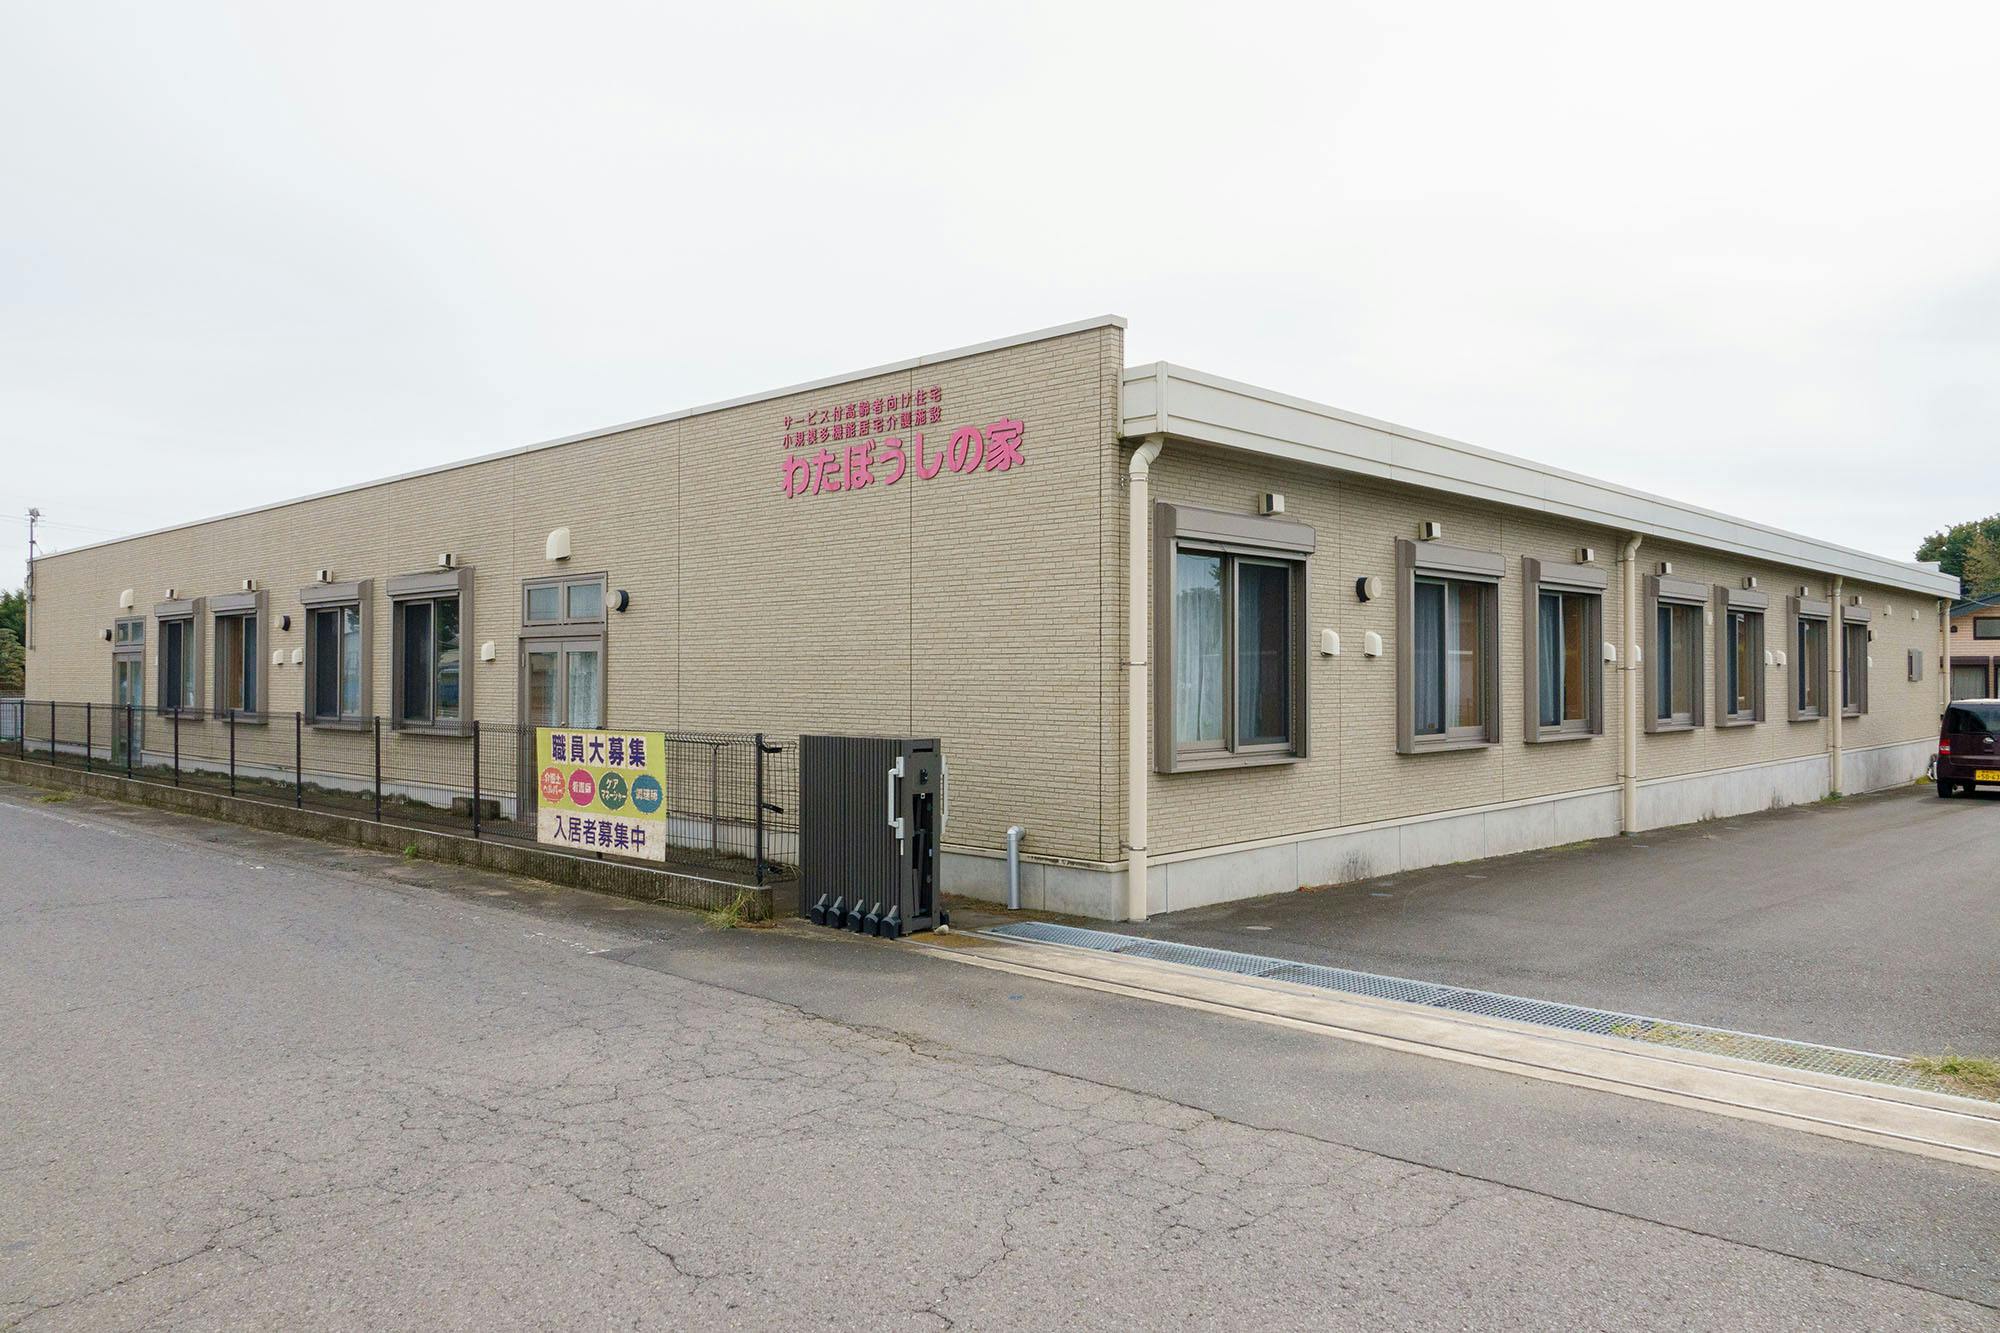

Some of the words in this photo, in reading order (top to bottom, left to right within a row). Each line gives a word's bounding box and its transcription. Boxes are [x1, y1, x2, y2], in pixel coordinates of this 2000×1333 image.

[783, 385, 942, 430] サービス付高齢者向け住宅
[783, 417, 1025, 498] わたぼうしの家
[552, 734, 645, 767] 職員大募集
[553, 815, 646, 852] 入居者募集中
